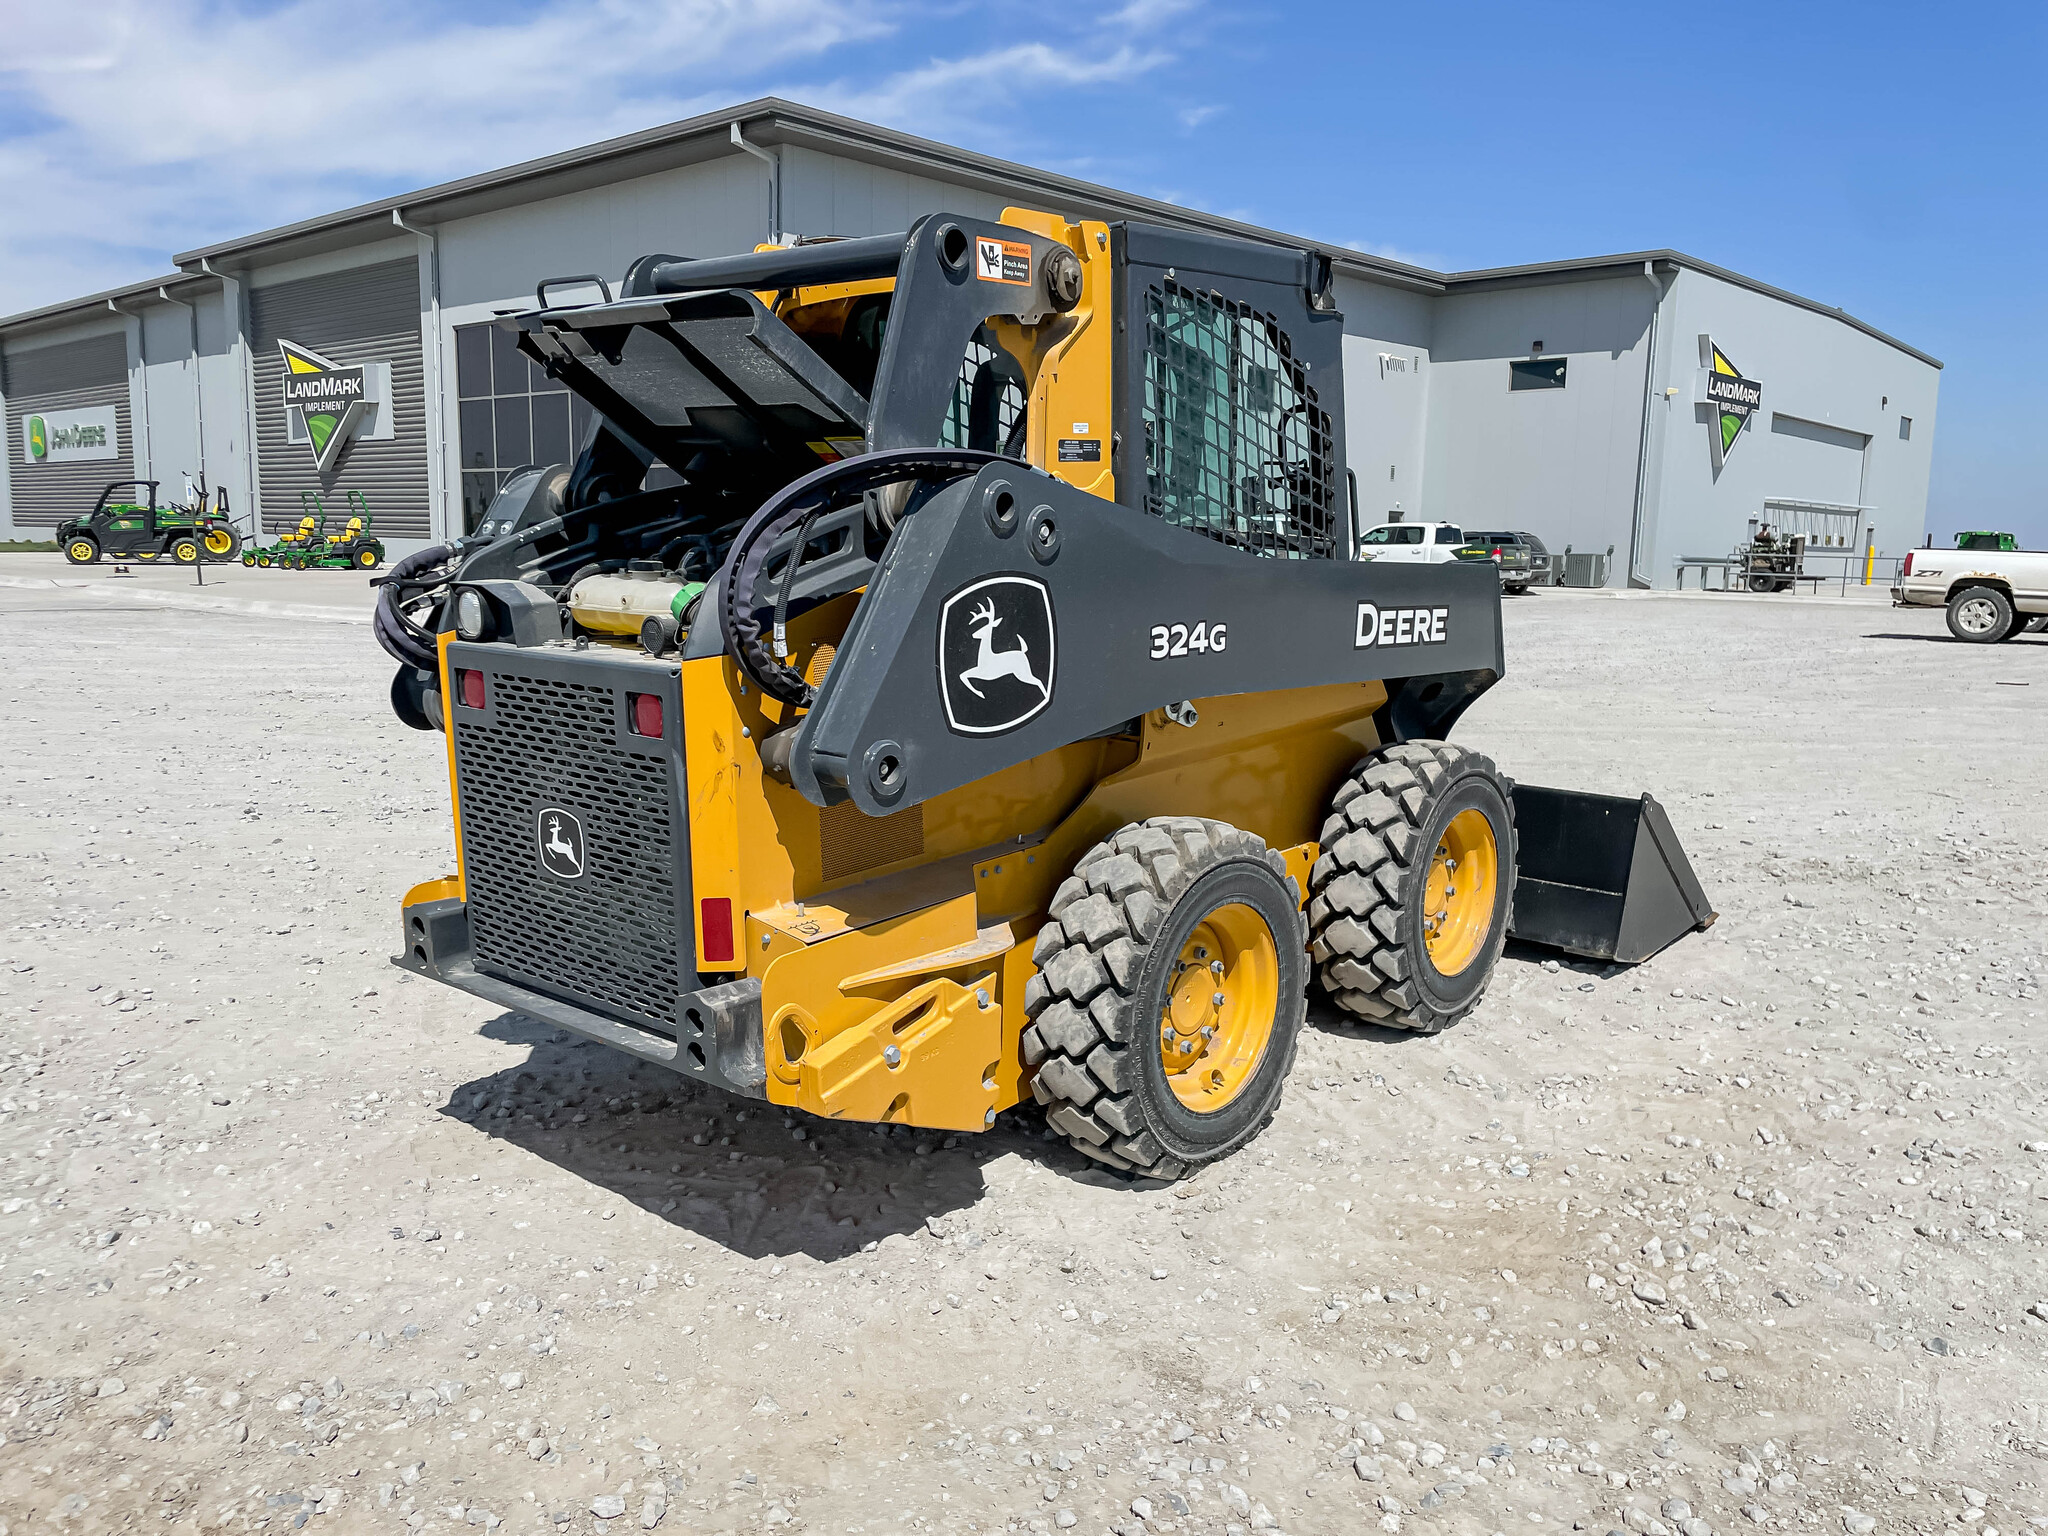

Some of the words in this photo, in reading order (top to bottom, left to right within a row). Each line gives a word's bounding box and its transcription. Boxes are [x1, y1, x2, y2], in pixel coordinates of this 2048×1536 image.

[1003, 259, 1017, 268] Pinch
[1017, 261, 1028, 270] Area
[1014, 271, 1025, 279] Away
[305, 400, 346, 412] IMPLEMENT
[1720, 401, 1749, 416] IMPLEMENT
[1355, 603, 1448, 647] DEERE
[1150, 621, 1227, 659] 324G
